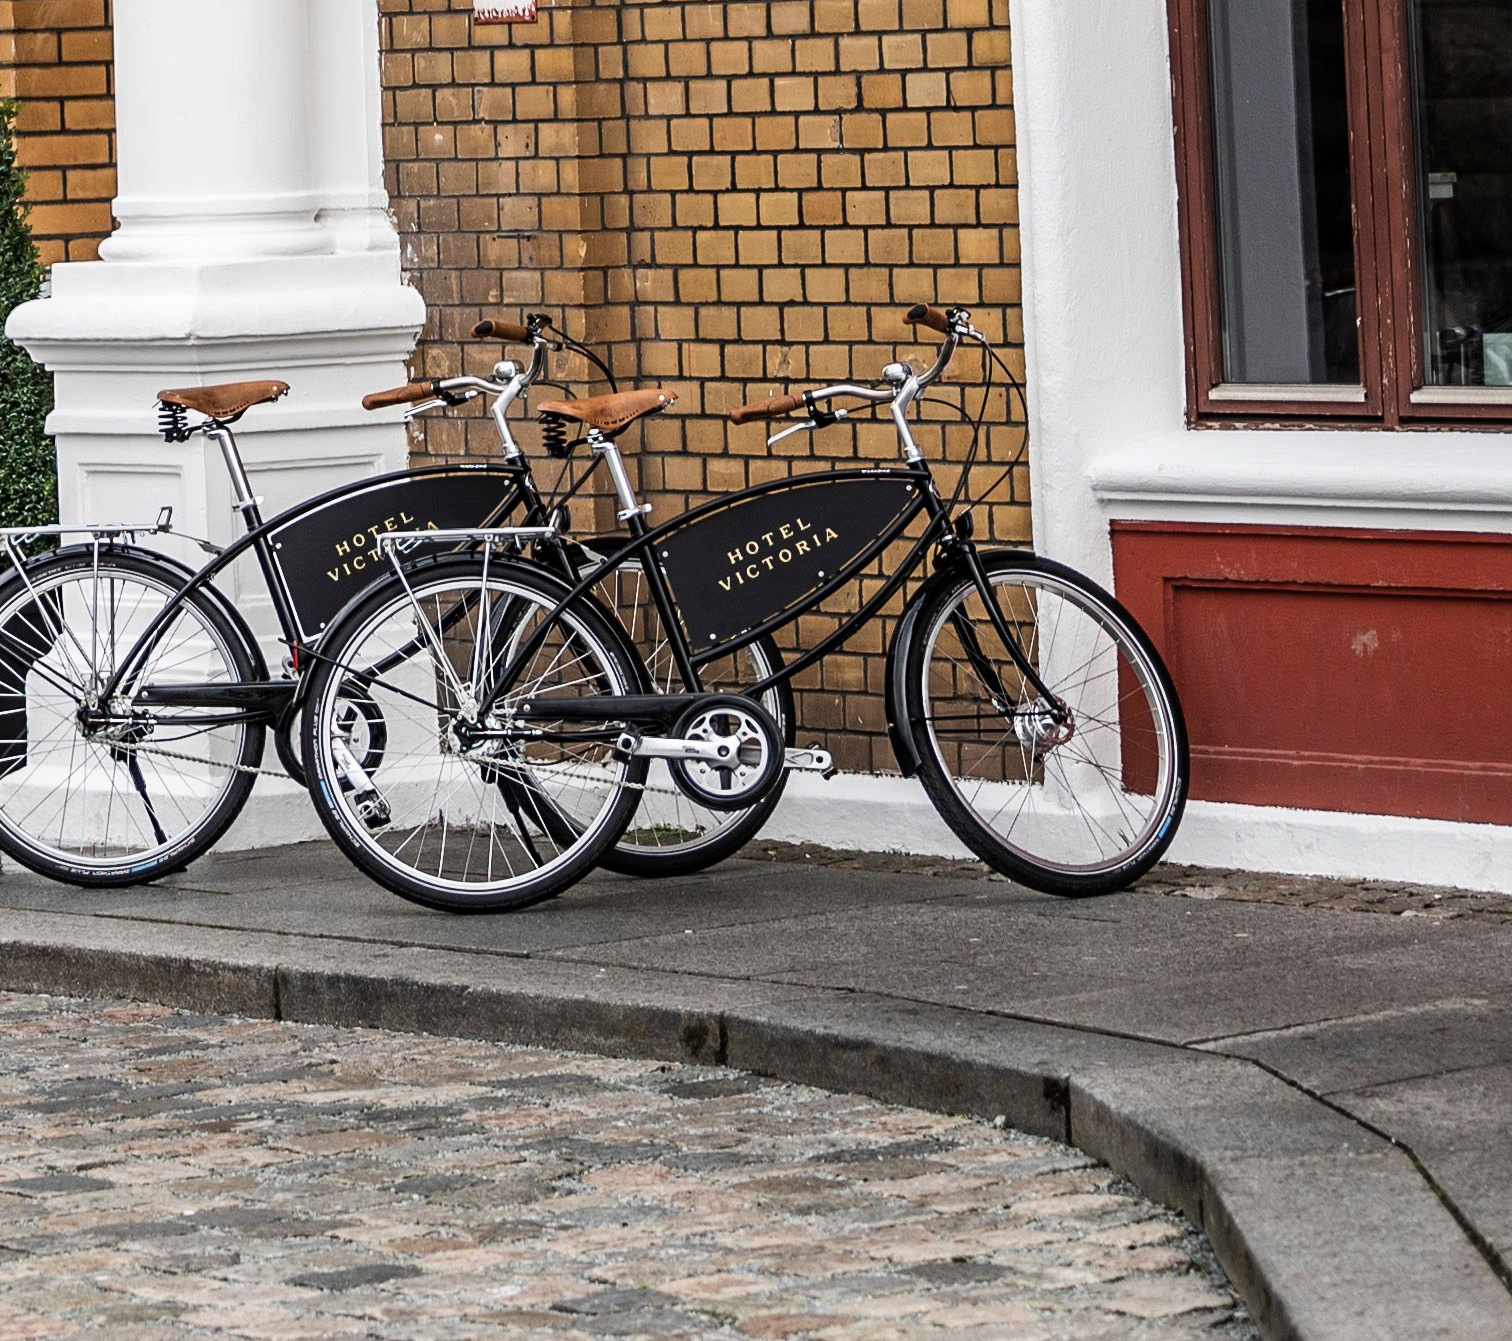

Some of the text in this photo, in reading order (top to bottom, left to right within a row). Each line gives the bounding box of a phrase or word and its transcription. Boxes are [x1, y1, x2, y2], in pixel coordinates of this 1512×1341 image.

[336, 512, 414, 556] HOTEL
[727, 517, 812, 565] HOTEL
[718, 527, 839, 591] VICTORIA
